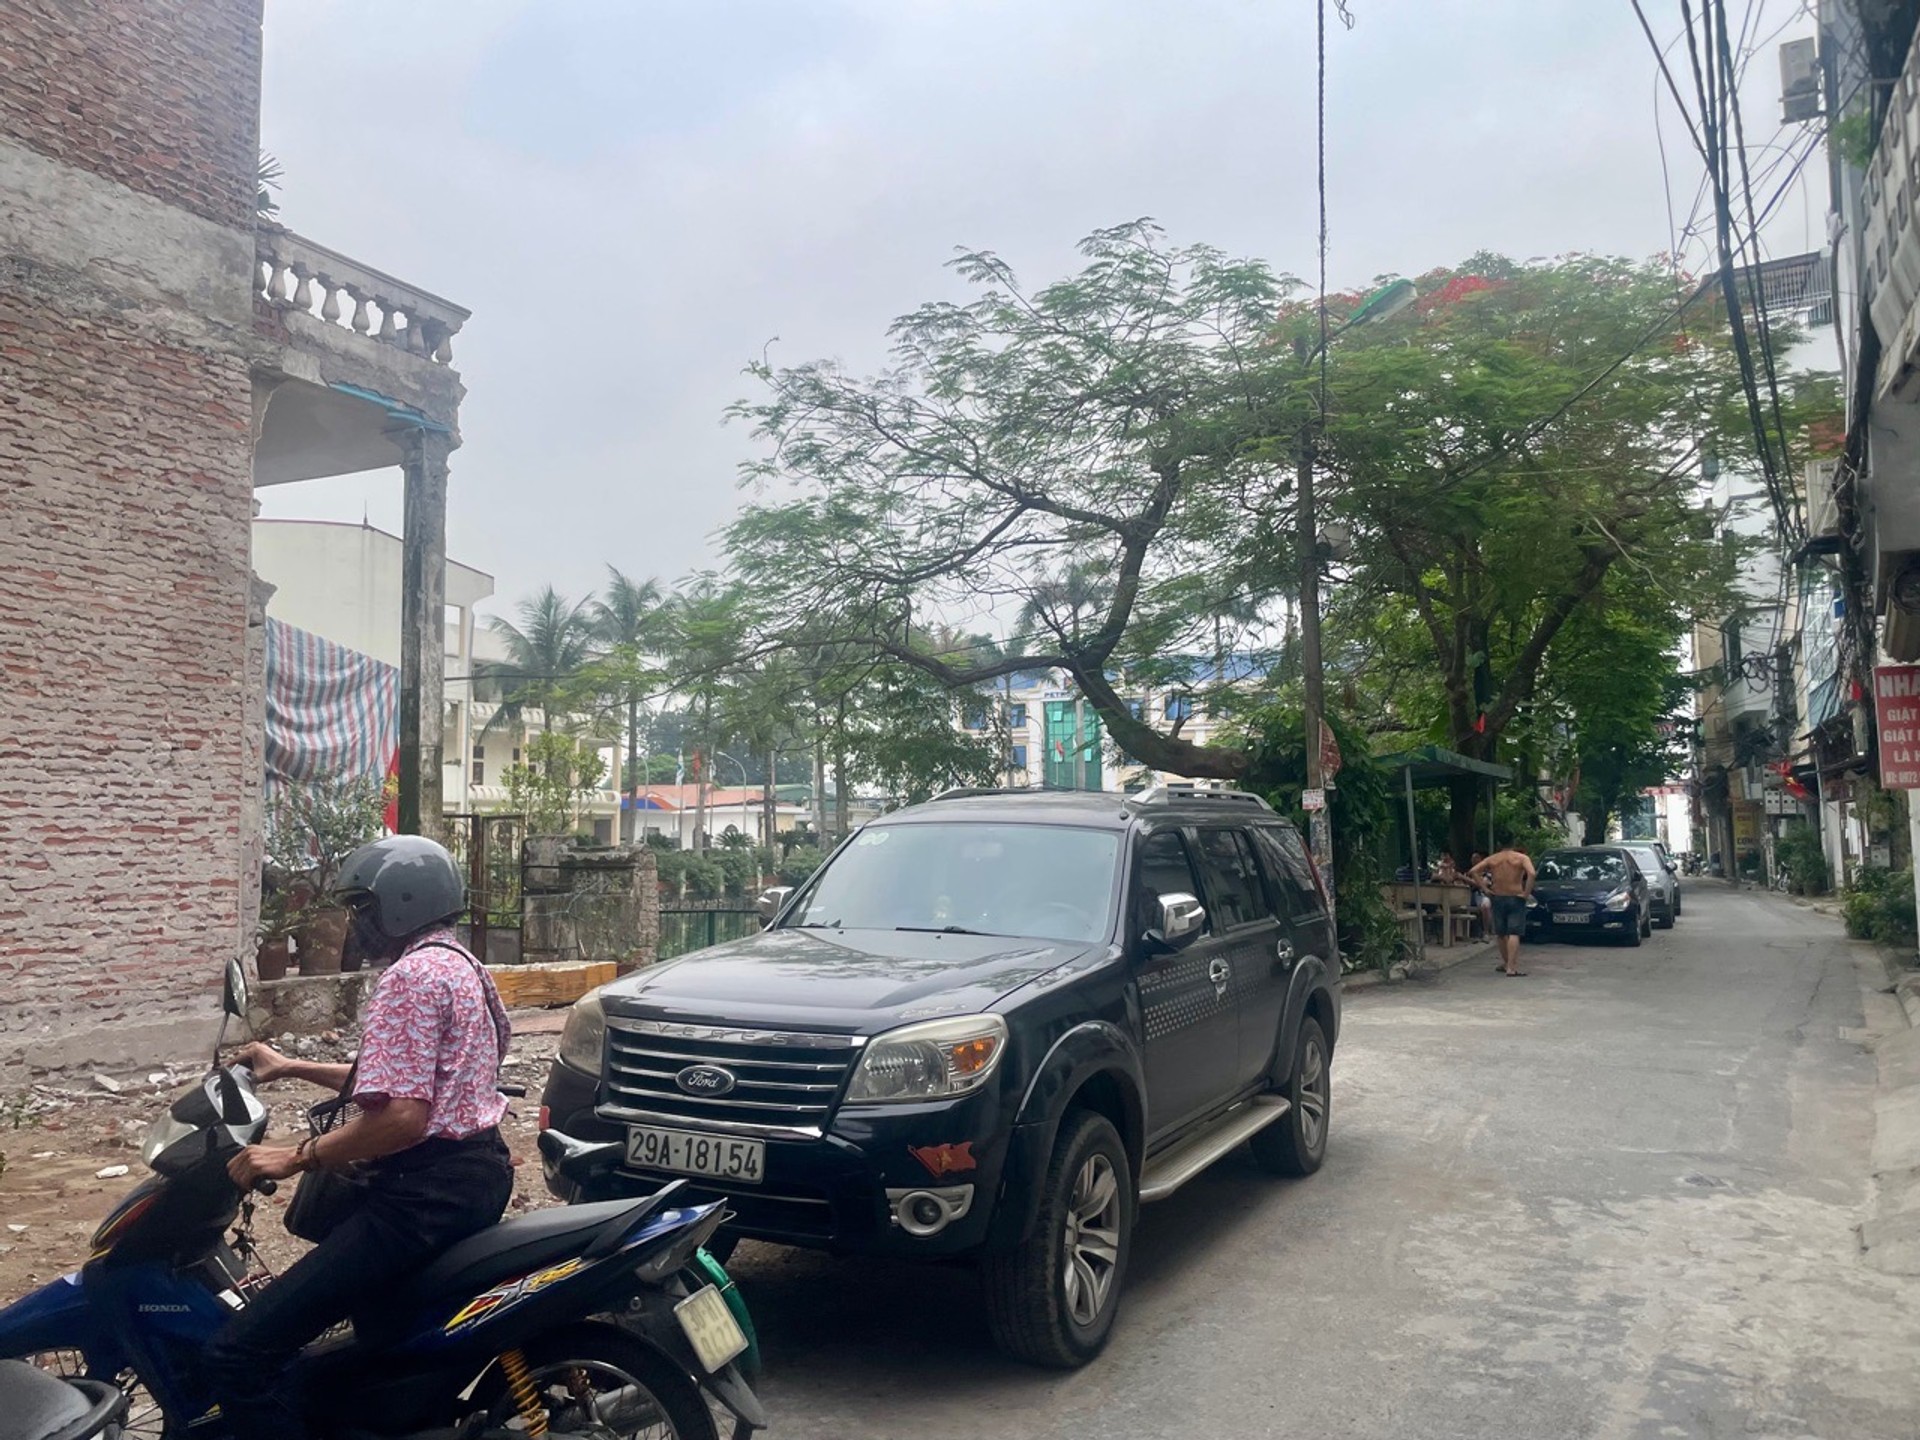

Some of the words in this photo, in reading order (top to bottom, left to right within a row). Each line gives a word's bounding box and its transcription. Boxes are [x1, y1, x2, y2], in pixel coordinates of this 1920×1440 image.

[631, 1017, 824, 1047] EVEREST
[687, 1071, 720, 1089] Ford
[630, 1130, 758, 1178] 29A-181.54
[138, 1303, 192, 1313] HONDA
